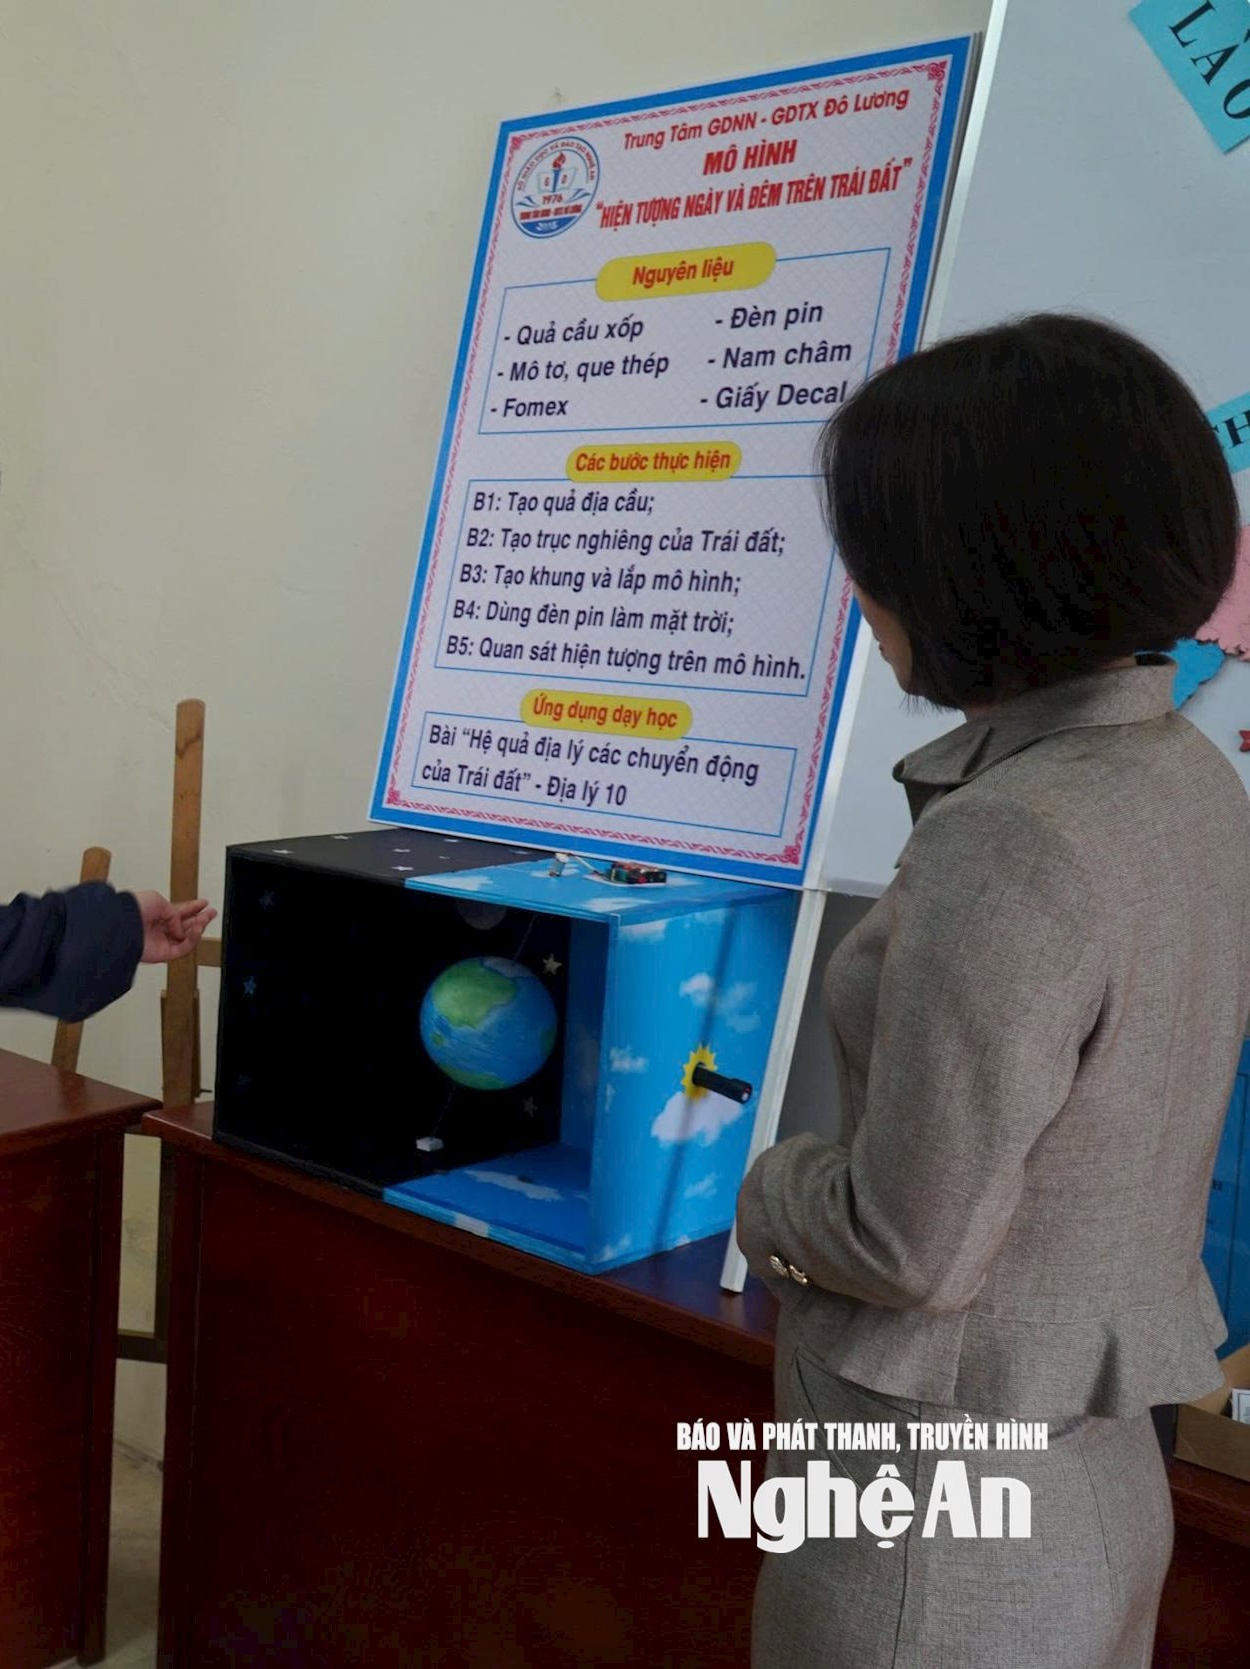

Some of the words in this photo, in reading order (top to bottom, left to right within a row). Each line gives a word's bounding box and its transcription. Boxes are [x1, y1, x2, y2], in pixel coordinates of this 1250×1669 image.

[624, 130, 665, 150] Trung
[671, 122, 702, 142] Tâm
[708, 112, 757, 136] GDNN
[772, 101, 819, 125] GDTX
[824, 95, 848, 117] Đô
[853, 89, 909, 111] Lương
[703, 144, 738, 175] MÔ
[743, 139, 797, 169] HÌNH
[636, 196, 681, 227] TƯỢNG
[683, 187, 723, 218] NGÀY
[726, 182, 745, 212] VÀ
[747, 179, 783, 210] ĐÊM
[786, 172, 826, 205] TRÊN
[830, 166, 866, 199] TRÁI
[632, 260, 697, 289] Nguyên
[702, 256, 734, 282] liệu
[517, 321, 556, 345] Quả
[562, 317, 599, 342] cầu
[605, 313, 644, 342] xốp
[730, 305, 777, 329] Đèn
[783, 301, 823, 330] pin
[509, 360, 539, 381] Mô
[545, 360, 569, 382] tơ,
[576, 358, 615, 382] que
[622, 352, 669, 378] thép
[722, 347, 776, 369] Nam
[784, 340, 852, 365] châm
[503, 398, 568, 417] Fomex
[716, 382, 770, 413] Giấy
[776, 380, 848, 406] Decal
[576, 453, 606, 471] Các
[609, 452, 648, 471] bước
[653, 452, 689, 475] thực
[693, 450, 731, 472] hiện
[473, 492, 501, 512] B1:
[508, 492, 538, 515] Tạo
[543, 489, 575, 517] quả
[581, 491, 608, 516] địa
[614, 488, 654, 515] cầu;
[466, 528, 495, 547] B2:
[501, 528, 532, 552] Tạo
[537, 530, 571, 553] trục
[576, 529, 652, 556] nghiêng
[659, 527, 693, 551] của
[701, 529, 739, 552] Trái
[745, 527, 786, 557] đất;
[460, 563, 487, 584] B3:
[494, 564, 524, 588] Tạo
[529, 566, 585, 593] khung
[592, 567, 612, 589] và
[617, 564, 646, 595] lắp
[652, 569, 683, 592] mô
[688, 569, 741, 597] hình;
[453, 599, 481, 619] B4:
[486, 601, 532, 628] Dùng
[537, 603, 570, 625] đèn
[575, 605, 604, 631] pin
[610, 605, 643, 629] làm
[650, 610, 688, 635] mặt
[693, 610, 734, 637] trời;
[446, 635, 474, 656] B5:
[479, 637, 524, 660] Quan
[529, 641, 557, 661] sát
[561, 642, 601, 669] hiện
[607, 646, 661, 675] tượng
[668, 650, 707, 673] trên
[714, 653, 746, 676] mô
[752, 654, 805, 680] hình.
[533, 692, 563, 721] Ứng
[567, 700, 608, 726] dụng
[612, 705, 642, 729] dạy
[646, 707, 678, 730] học
[429, 721, 457, 746] Bài
[497, 731, 529, 758] quả
[534, 736, 561, 762] địa
[567, 738, 584, 766] lý
[589, 742, 621, 765] các
[627, 744, 699, 777] chuyển
[705, 754, 759, 787] động
[422, 759, 451, 783] của
[458, 764, 489, 787] Trái
[546, 775, 576, 802] Địa
[581, 780, 600, 807] lý
[606, 784, 627, 806] 10
